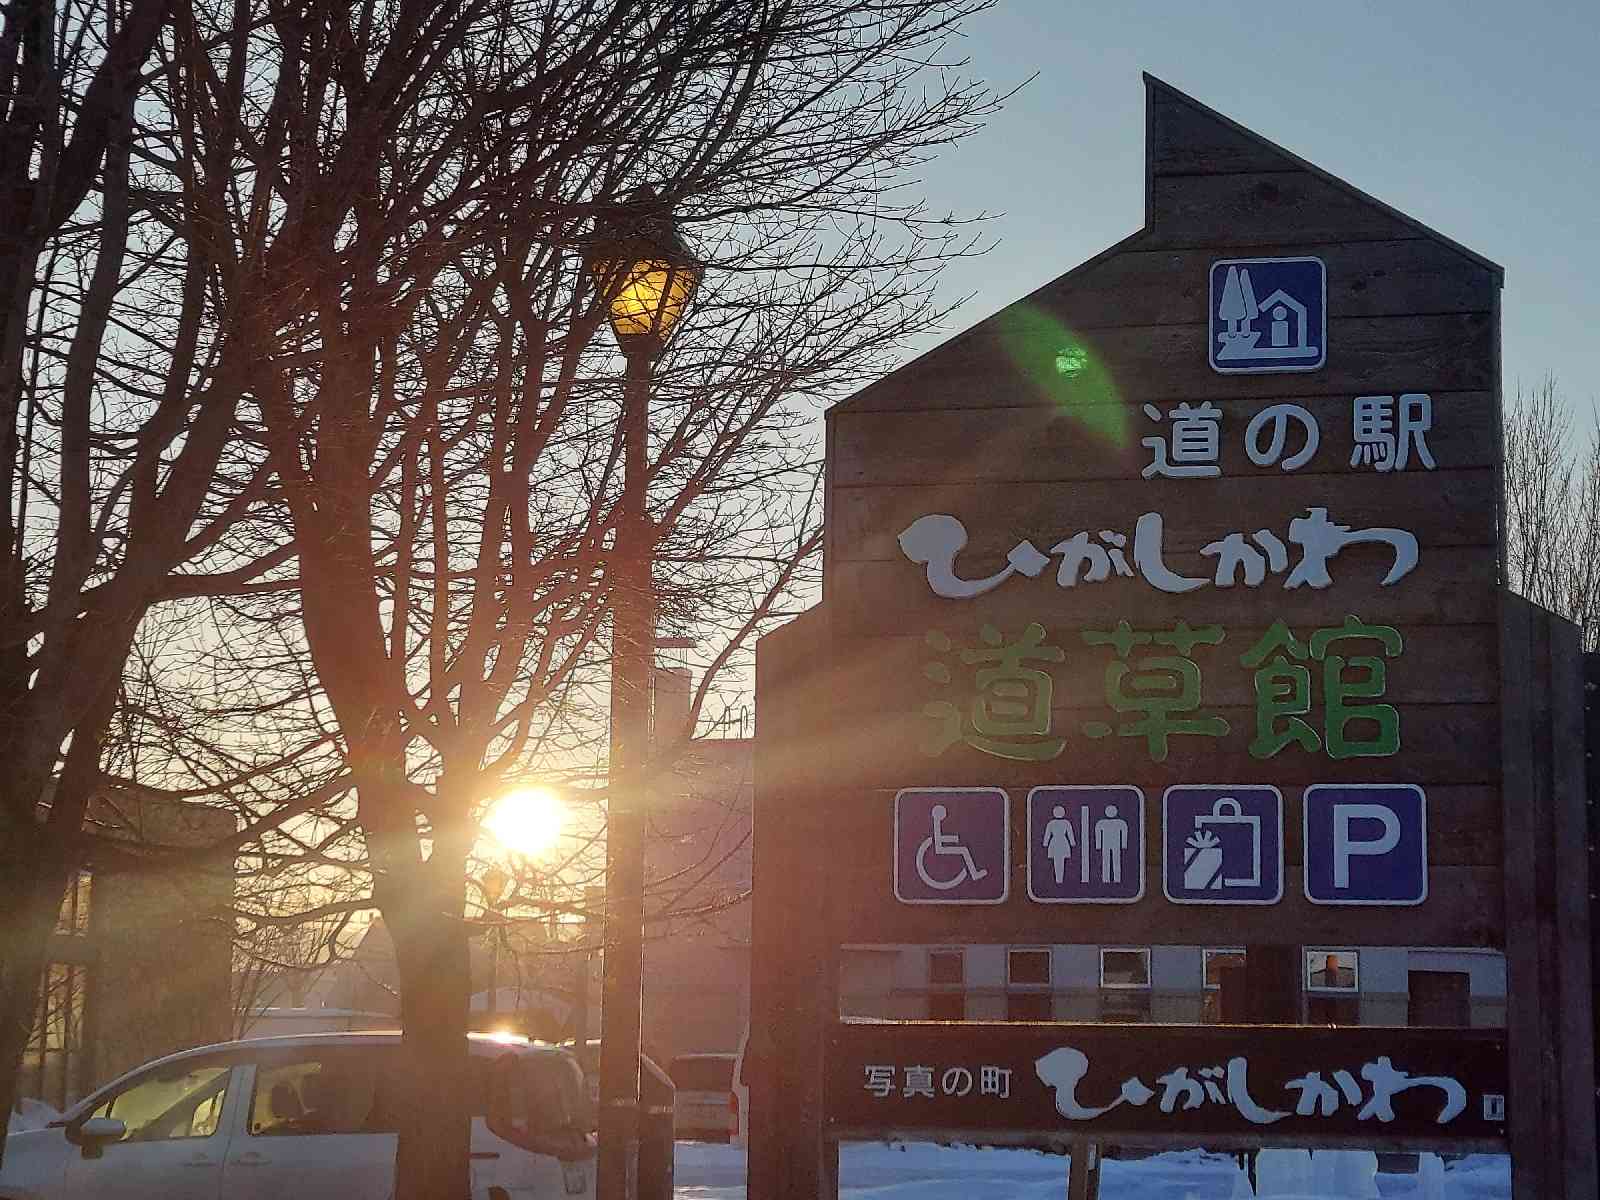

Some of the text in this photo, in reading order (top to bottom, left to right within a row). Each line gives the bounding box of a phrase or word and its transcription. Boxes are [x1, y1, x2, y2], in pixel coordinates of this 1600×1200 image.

[1142, 393, 1436, 479] 道の駅
[897, 507, 1418, 599] ひがしかわ
[920, 614, 1403, 761] 道草館
[1333, 804, 1401, 888] P
[863, 1064, 1013, 1098] 写真の町
[1035, 1046, 1467, 1124] ひがしかわ
